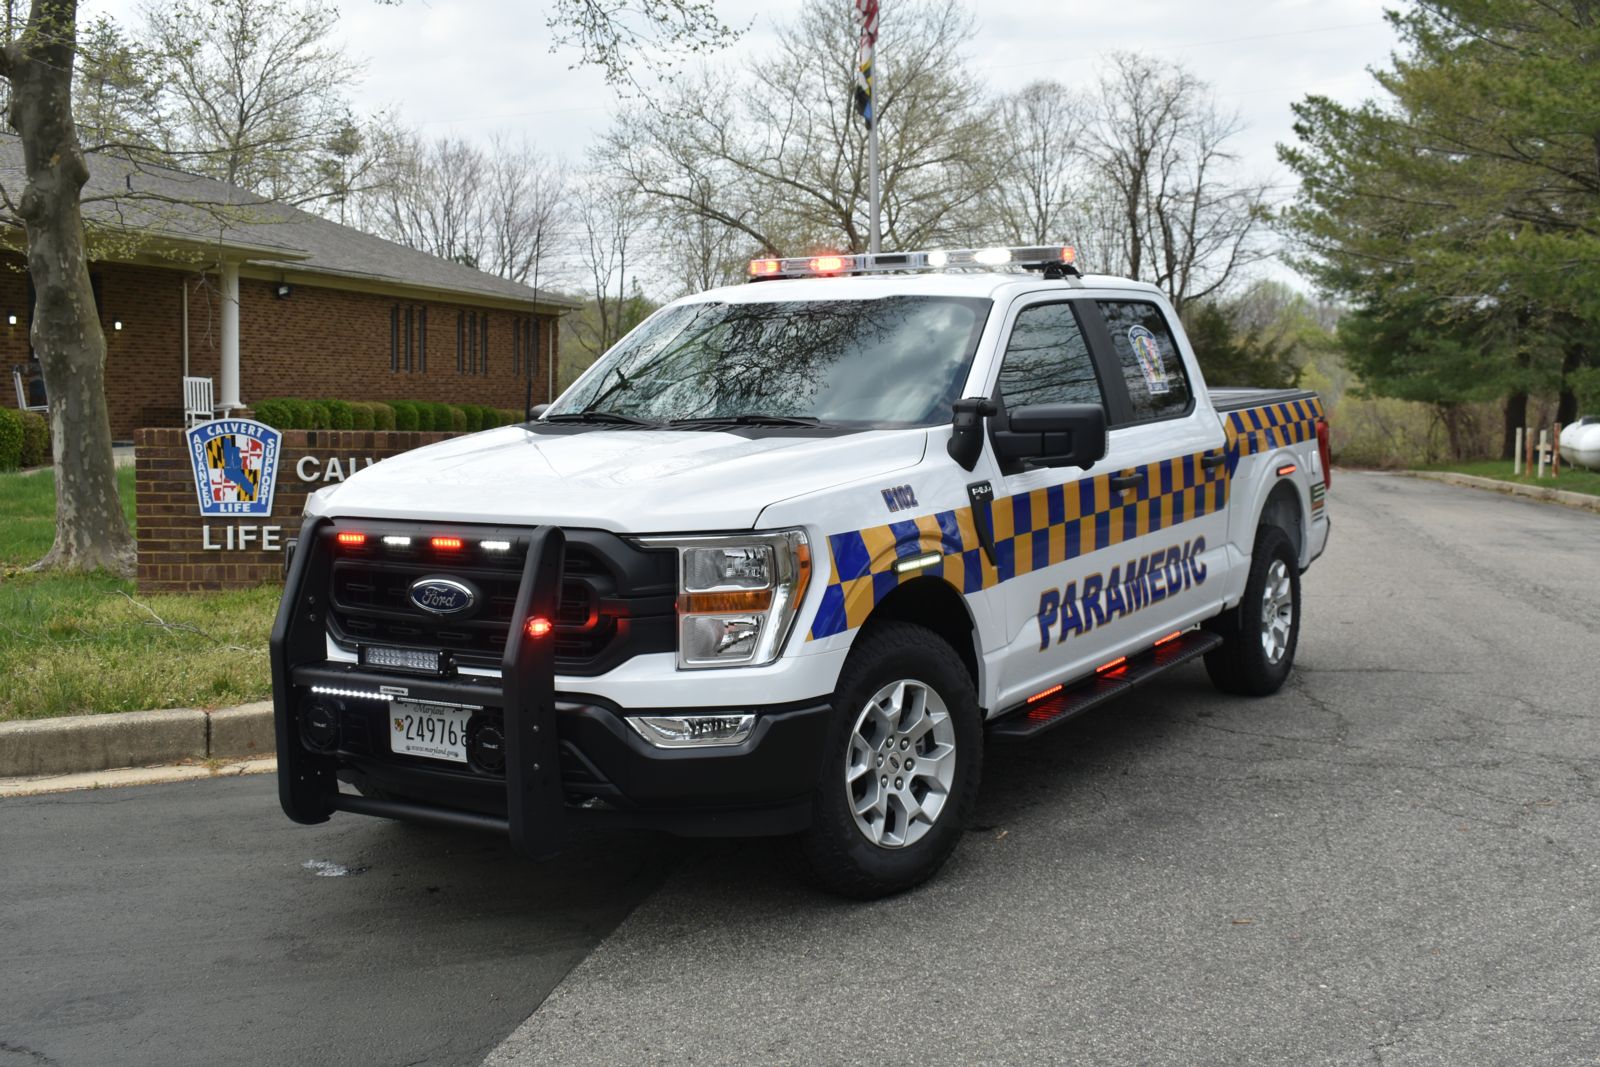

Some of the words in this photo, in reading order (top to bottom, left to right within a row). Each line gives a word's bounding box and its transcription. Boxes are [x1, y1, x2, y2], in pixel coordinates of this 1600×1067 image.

[206, 423, 264, 438] CALVERT
[193, 433, 212, 508] ADVANCED
[258, 438, 275, 505] SUPPORT
[296, 455, 387, 482] CAL
[220, 503, 251, 513] LIFE
[202, 525, 281, 550] LIFE
[421, 586, 457, 607] Ford
[1038, 535, 1207, 652] PARAMEDIC
[405, 715, 457, 746] 24976
